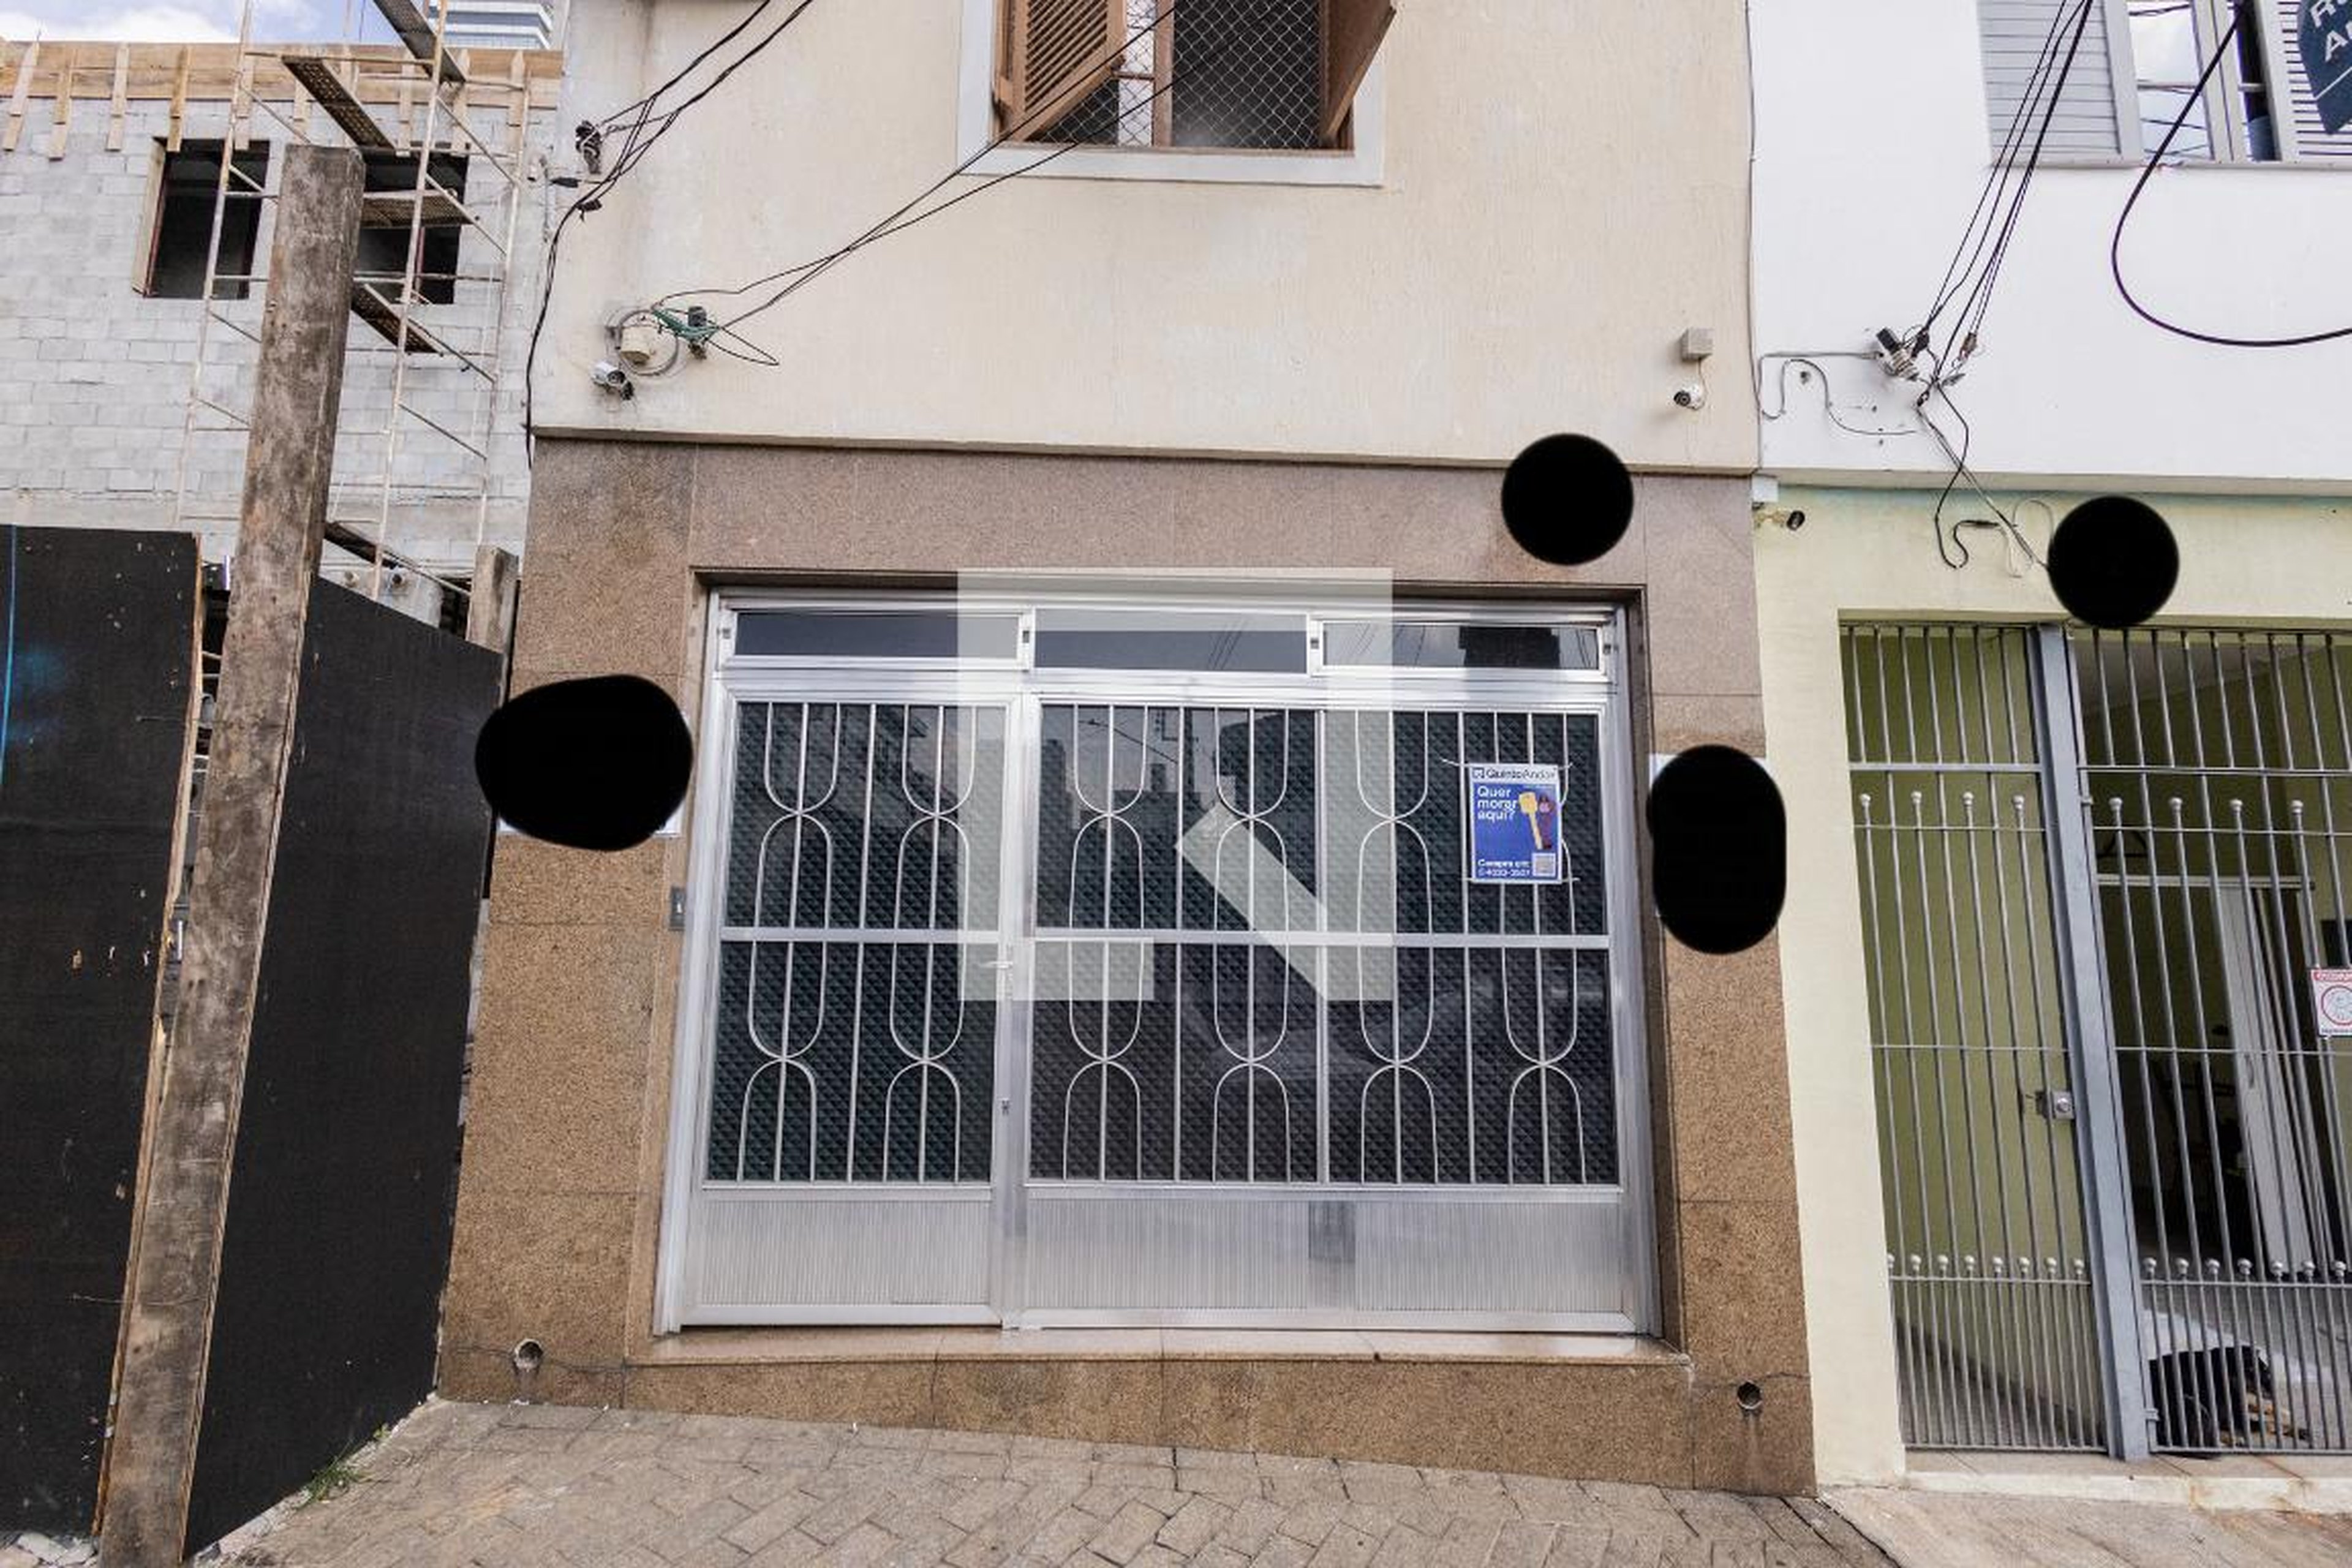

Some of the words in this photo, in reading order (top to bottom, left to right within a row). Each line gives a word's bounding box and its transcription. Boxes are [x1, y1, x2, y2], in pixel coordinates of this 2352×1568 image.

[1477, 786, 1511, 797] Quer
[1477, 799, 1517, 809] morar
[1477, 809, 1515, 823] aqui?
